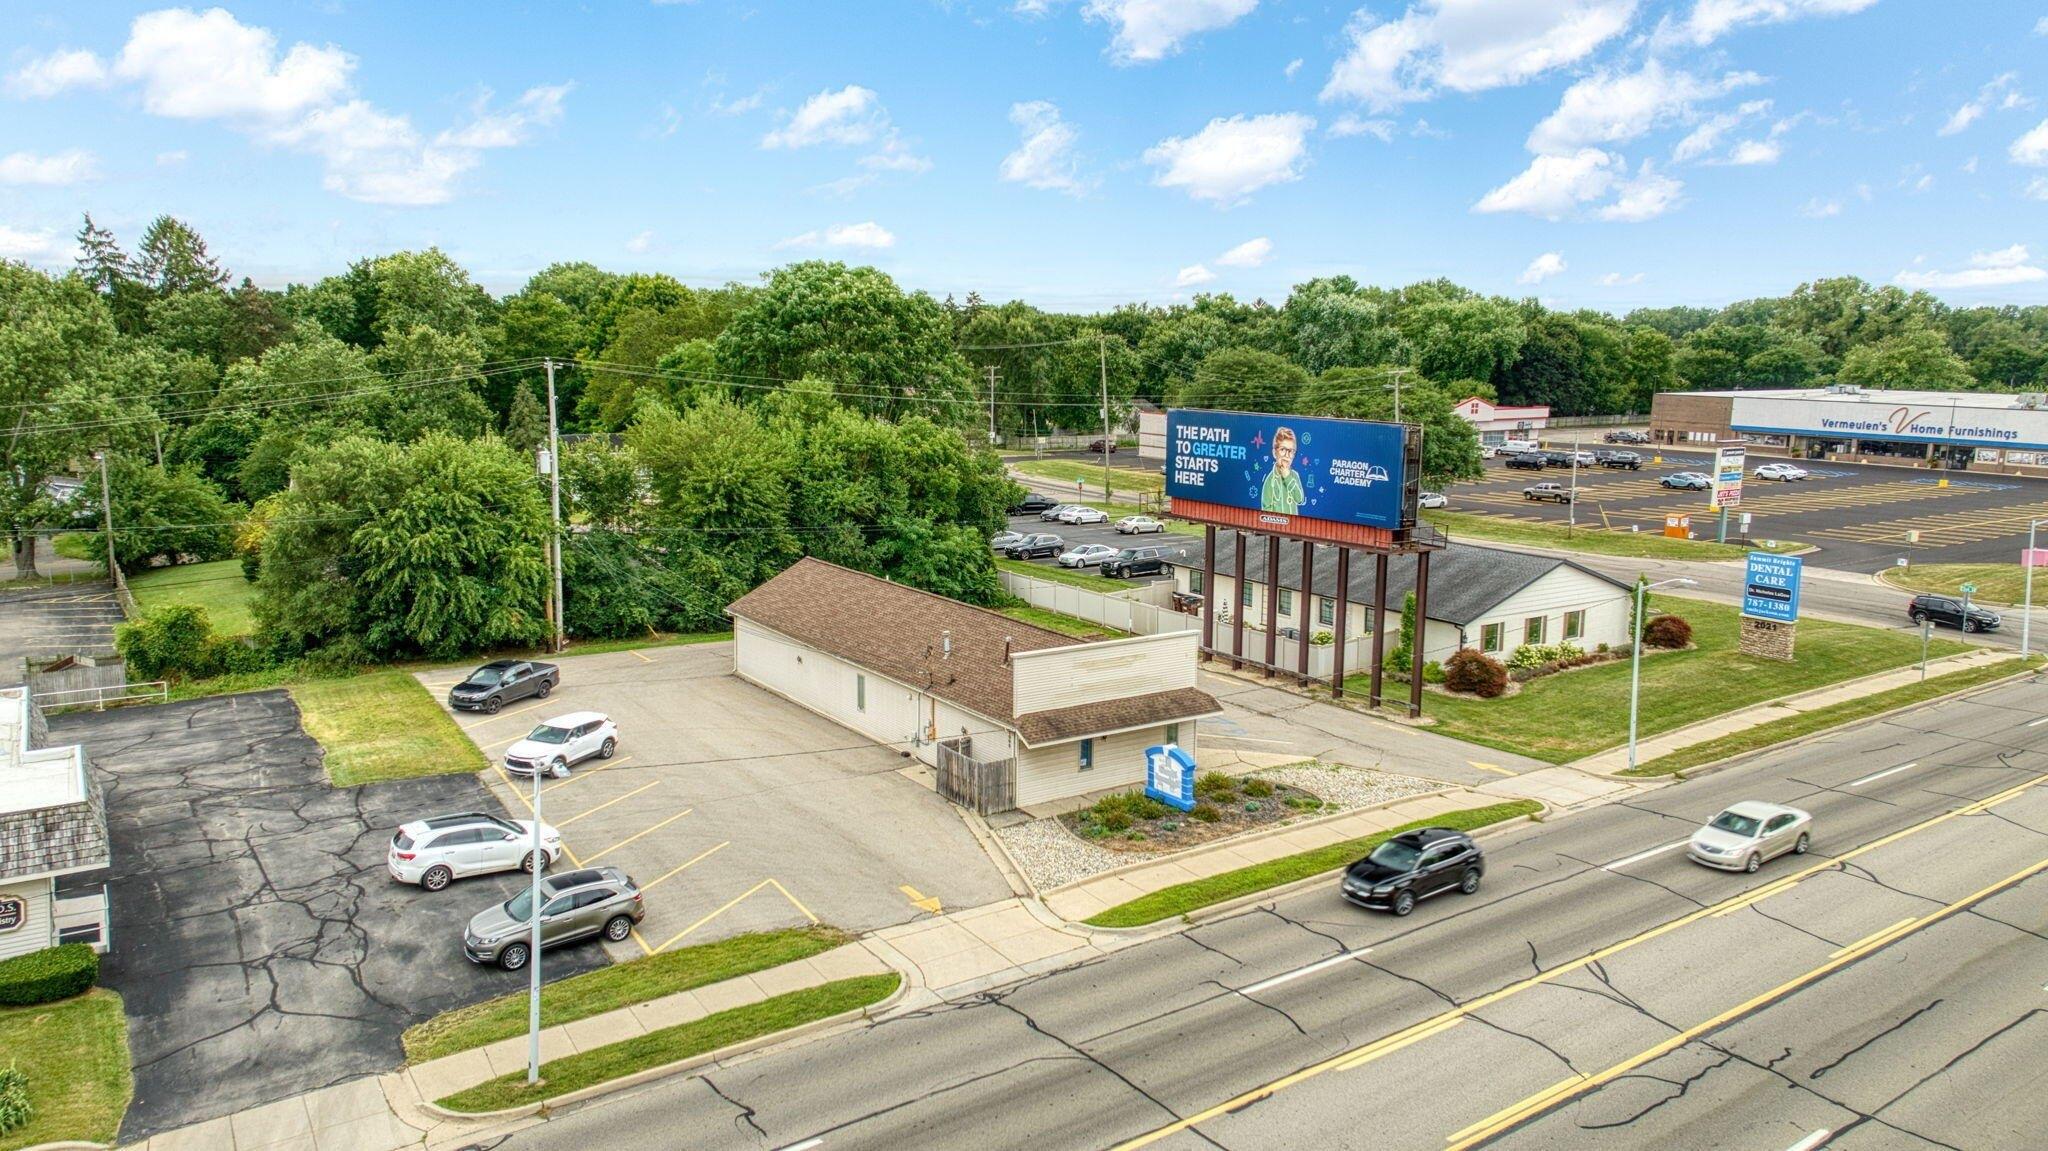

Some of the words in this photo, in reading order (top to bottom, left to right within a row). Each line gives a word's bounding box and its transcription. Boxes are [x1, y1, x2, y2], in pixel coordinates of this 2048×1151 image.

[1176, 425, 1199, 440] THE
[1200, 427, 1230, 443] PATH
[1821, 418, 1888, 431] Vermeulen's
[1910, 424, 1944, 435] Home
[1948, 425, 2018, 440] Furnishings
[1175, 440, 1191, 454] TO
[1192, 442, 1247, 460] GREATER
[1175, 455, 1219, 473] STARTS
[1332, 459, 1369, 471] PARAGON
[1174, 470, 1205, 487] HERE
[1329, 467, 1366, 479] CHARTER
[1333, 476, 1372, 488] ACADEMY
[1750, 554, 1772, 563] Summit
[1750, 563, 1793, 576] DENTAL
[1755, 574, 1786, 587] CARE
[1747, 598, 1790, 611] 787-1380
[1754, 621, 1777, 631] 2021
